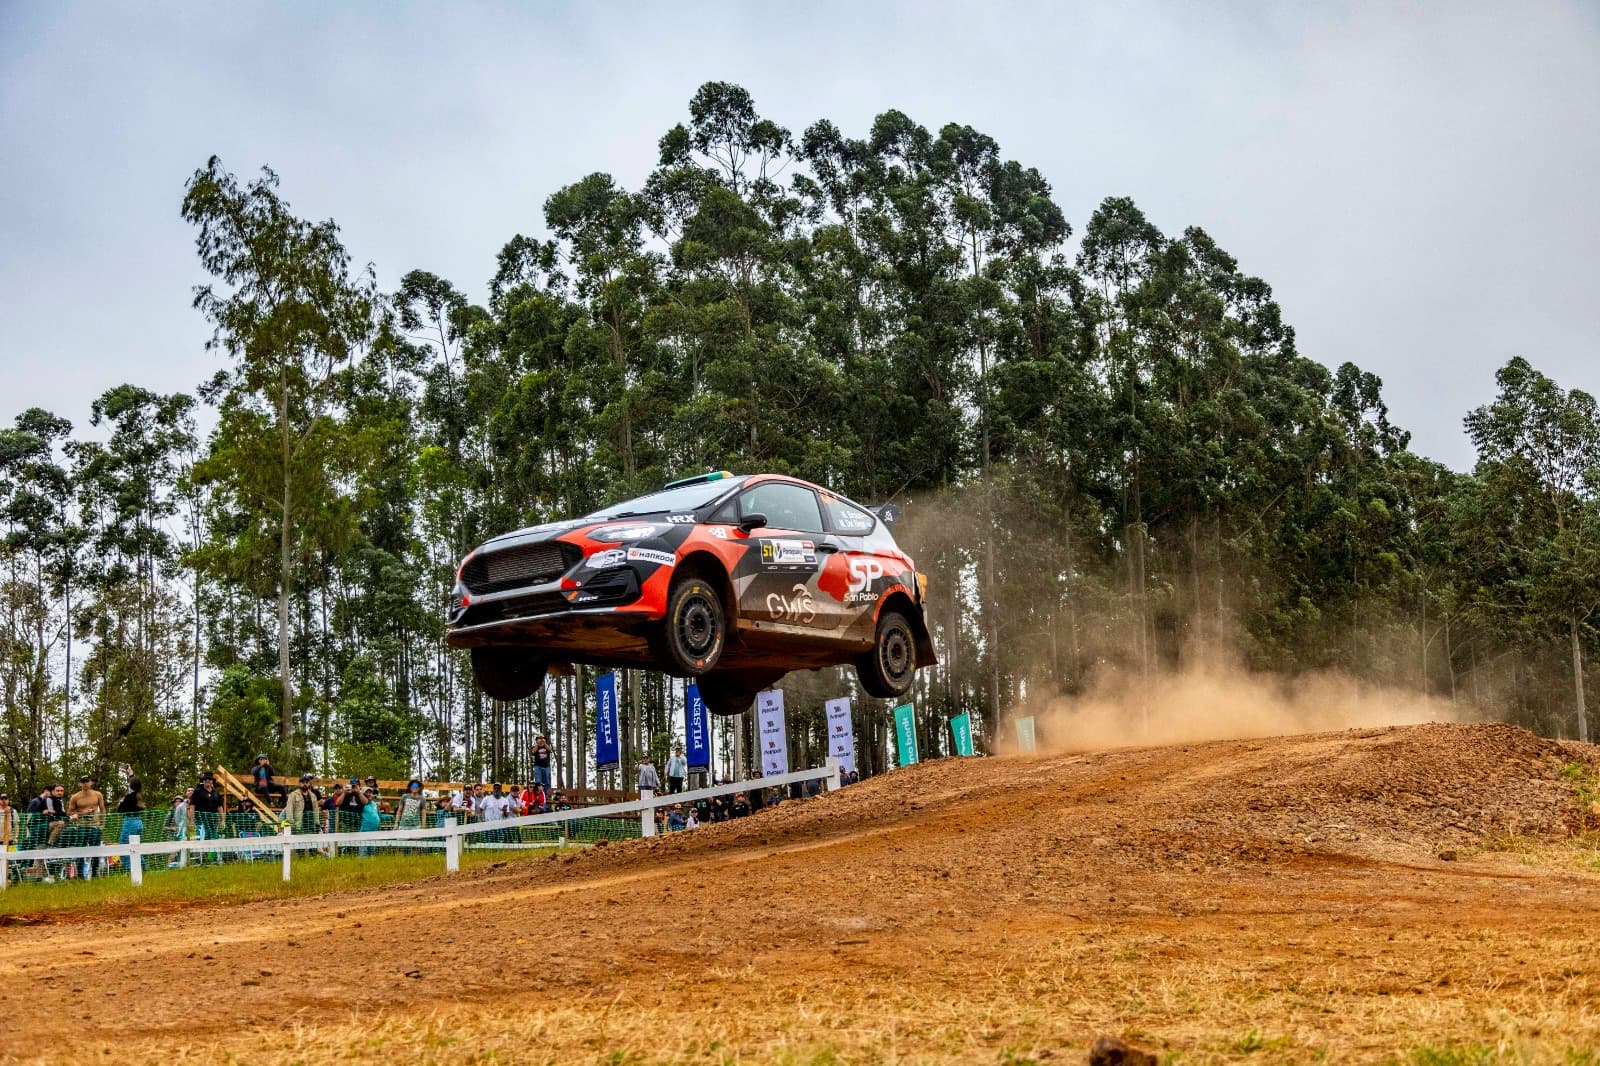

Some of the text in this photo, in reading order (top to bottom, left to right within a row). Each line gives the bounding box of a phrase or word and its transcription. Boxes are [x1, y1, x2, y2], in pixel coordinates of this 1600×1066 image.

[849, 558, 884, 593] SP
[766, 593, 816, 623] GWS
[844, 592, 879, 602] San Pablo
[693, 697, 703, 751] PILSEN
[902, 717, 912, 746] bank
